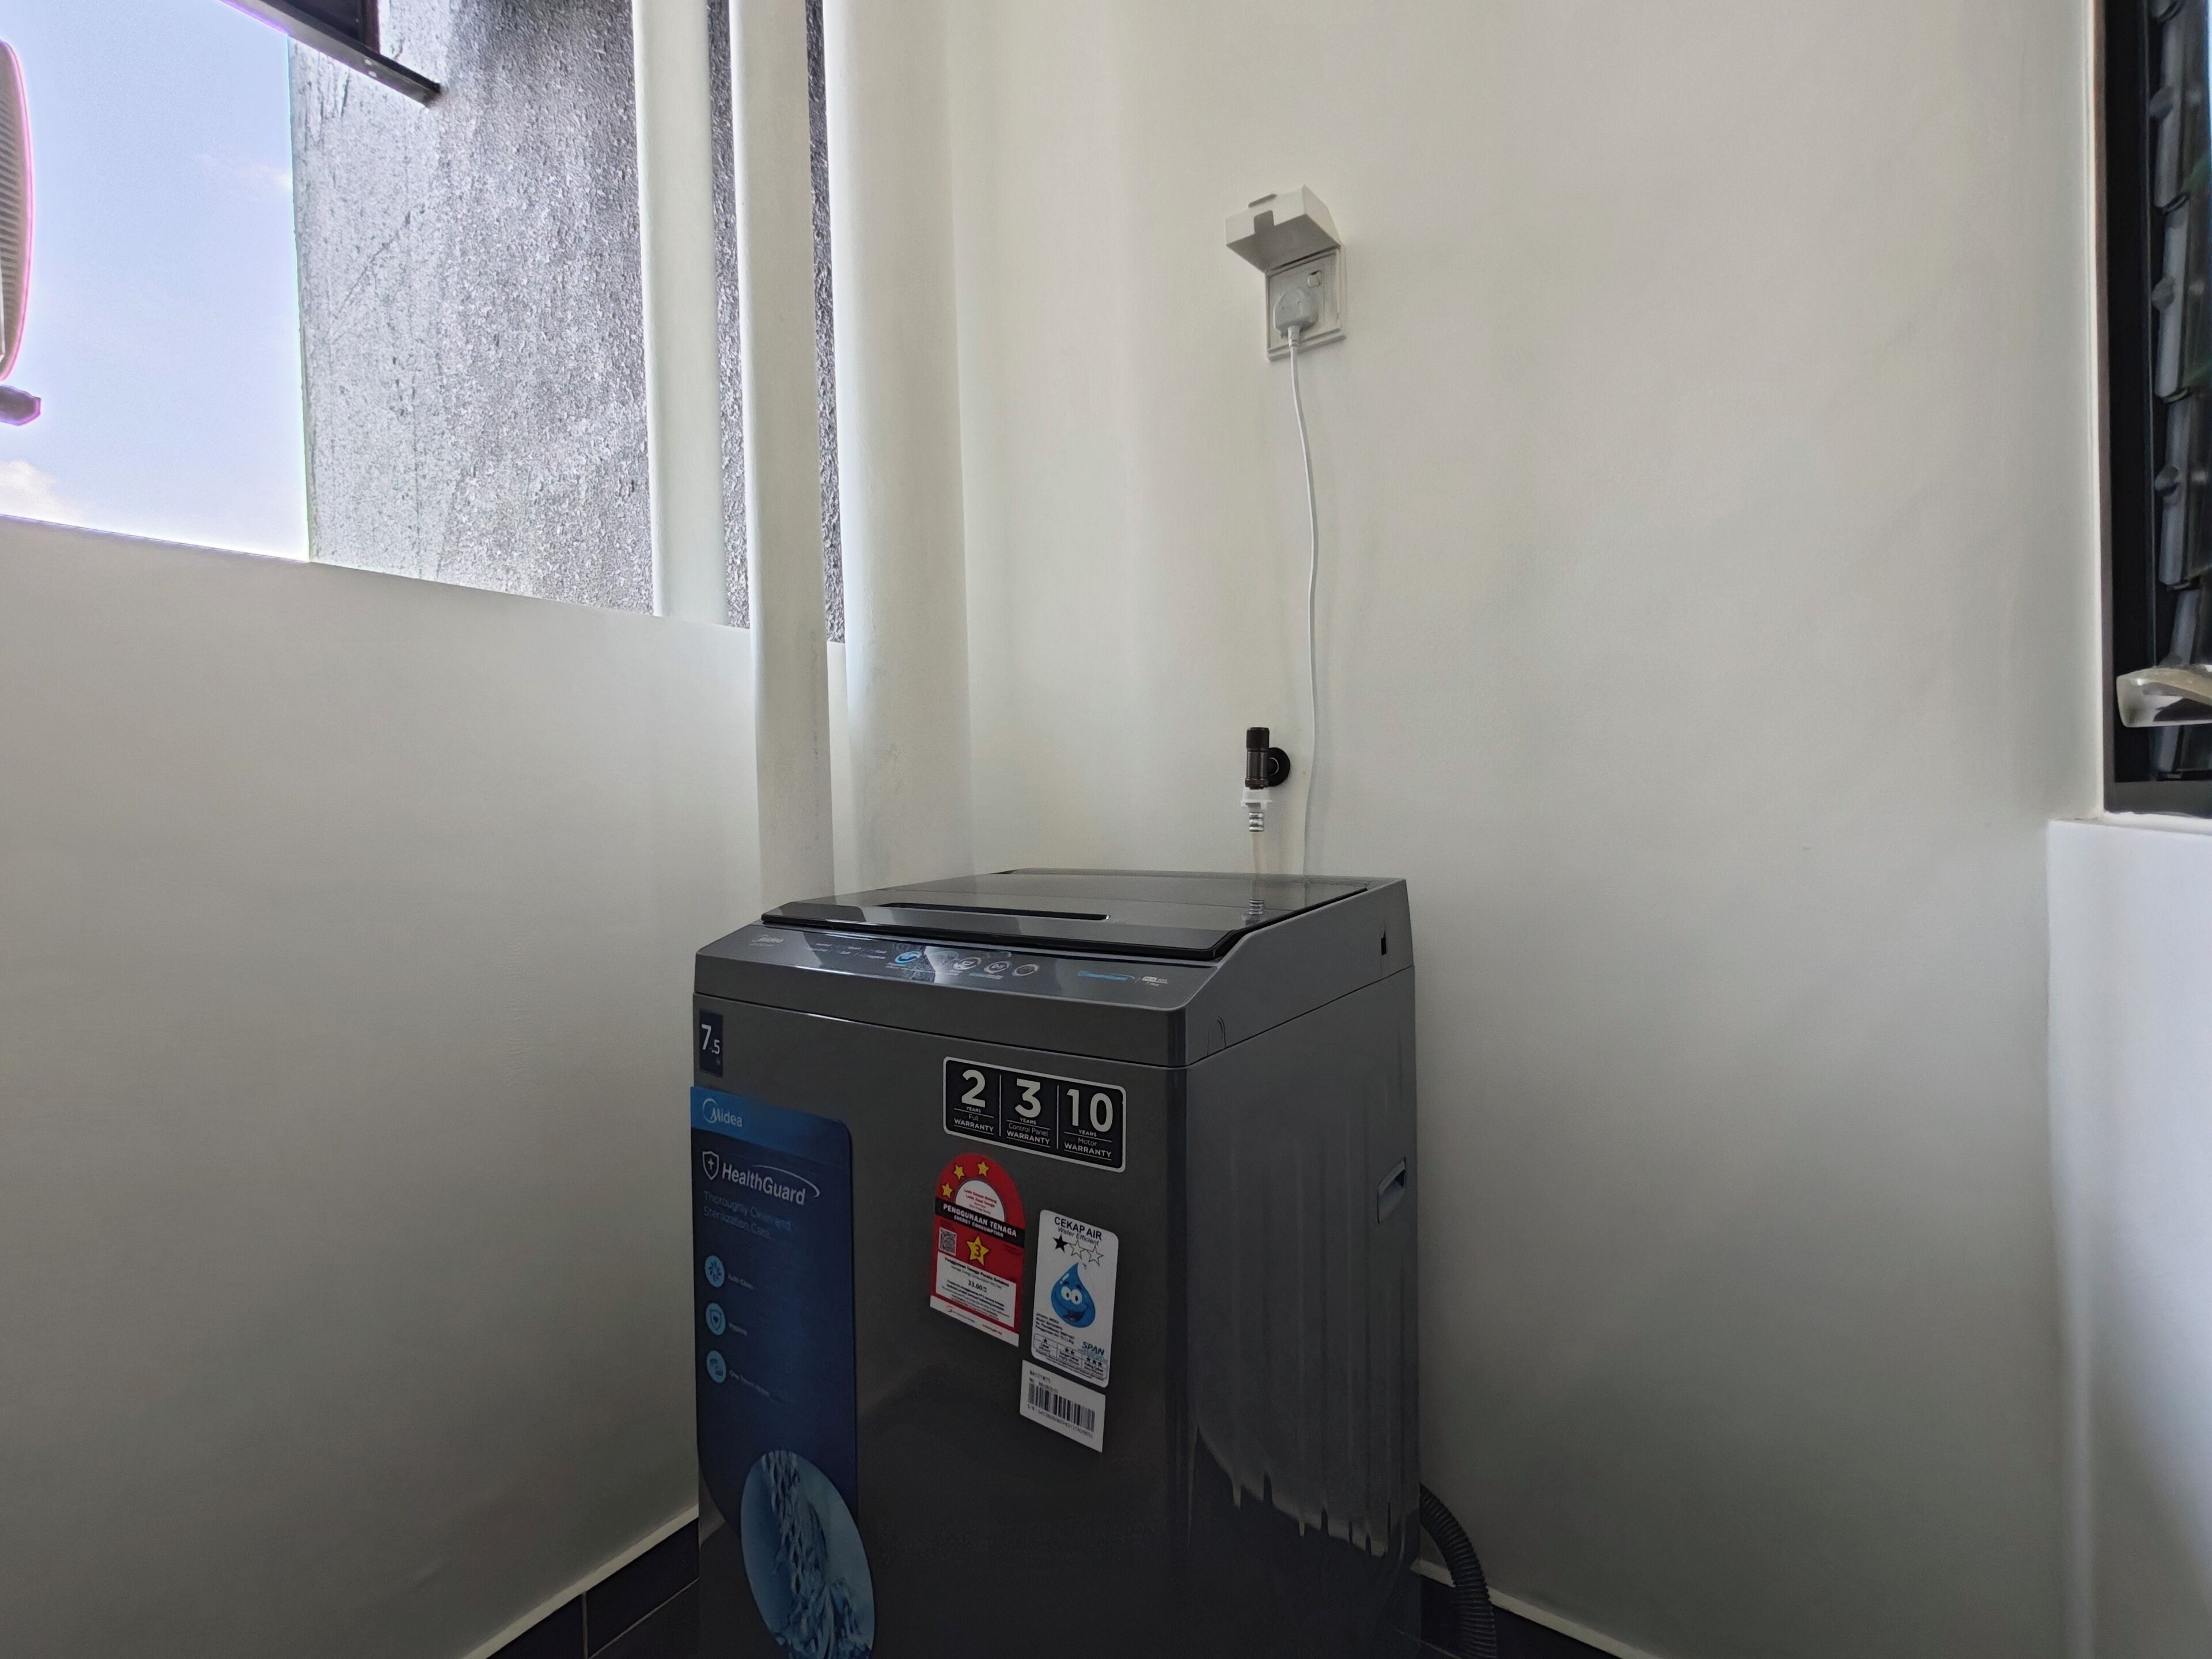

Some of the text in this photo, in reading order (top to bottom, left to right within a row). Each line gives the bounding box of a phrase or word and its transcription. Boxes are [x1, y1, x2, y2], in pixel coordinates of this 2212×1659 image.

[961, 1069, 986, 1108] 2
[1014, 1078, 1041, 1118] 3
[702, 1097, 742, 1127] Midea
[968, 1113, 979, 1122] Full
[1066, 1089, 1113, 1132] 10
[954, 1118, 994, 1132] WARRANTY
[1009, 1123, 1048, 1137] Control Panel
[1078, 1129, 1097, 1137] YEARS
[1006, 1130, 1050, 1145] WARRANTY
[1078, 1137, 1097, 1146] Motor
[1064, 1142, 1112, 1158] WARRANTY
[722, 1162, 806, 1206] HealthGuard
[943, 1203, 988, 1226] PENGGUNAAN
[990, 1221, 1017, 1237] TENAGA
[1054, 1216, 1103, 1241] CEKAP AIR
[1058, 1226, 1100, 1246] Water Efficient
[975, 1244, 981, 1257] 3
[1082, 1342, 1105, 1356] SPAN
